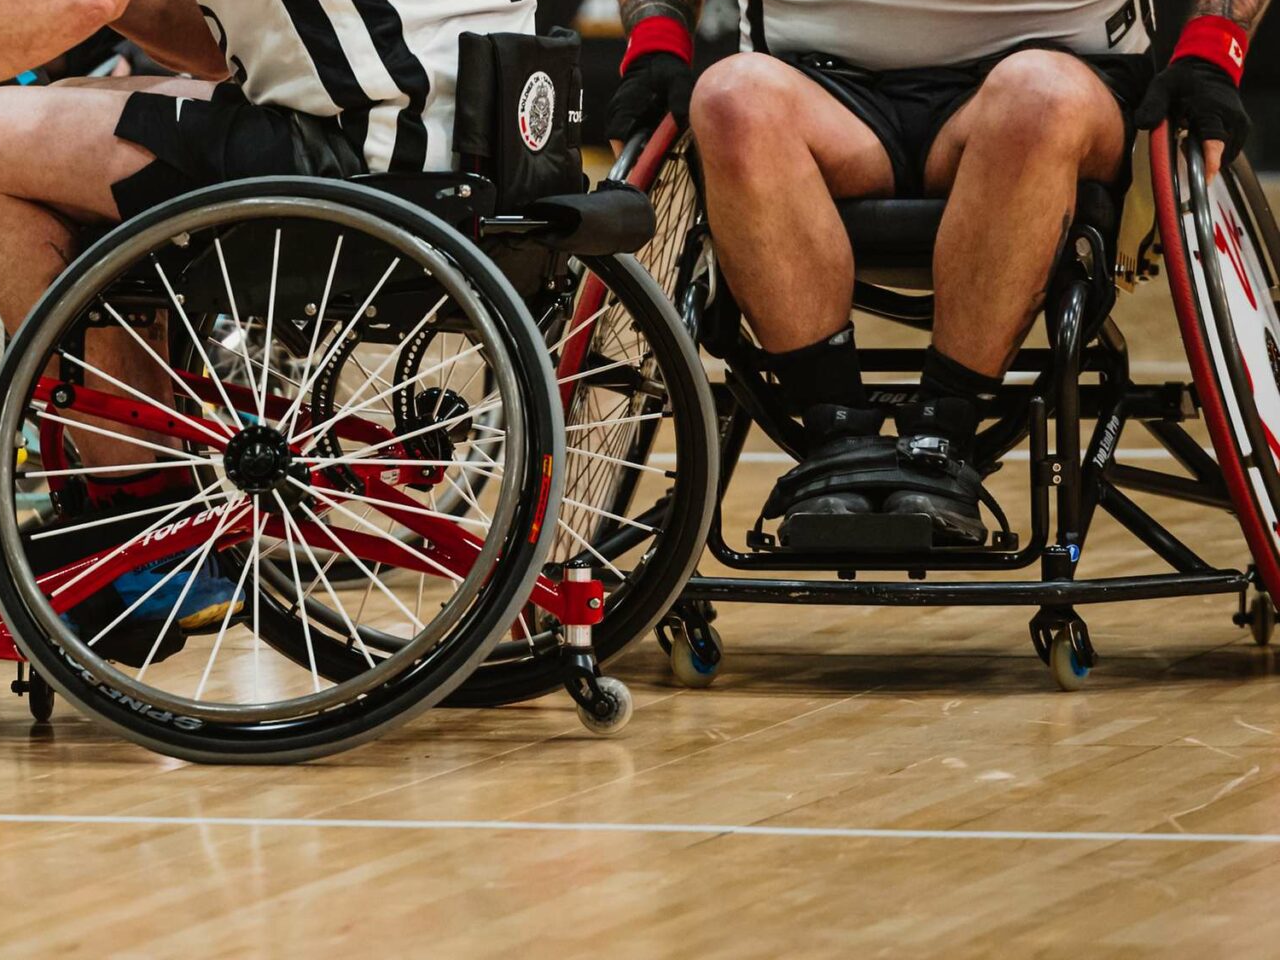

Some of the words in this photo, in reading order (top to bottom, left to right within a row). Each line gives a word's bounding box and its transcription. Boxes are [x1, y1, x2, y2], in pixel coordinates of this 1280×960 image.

[1106, 415, 1120, 436] Pro
[1100, 428, 1115, 452] End
[1092, 447, 1108, 469] Top
[139, 517, 192, 546] TOP
